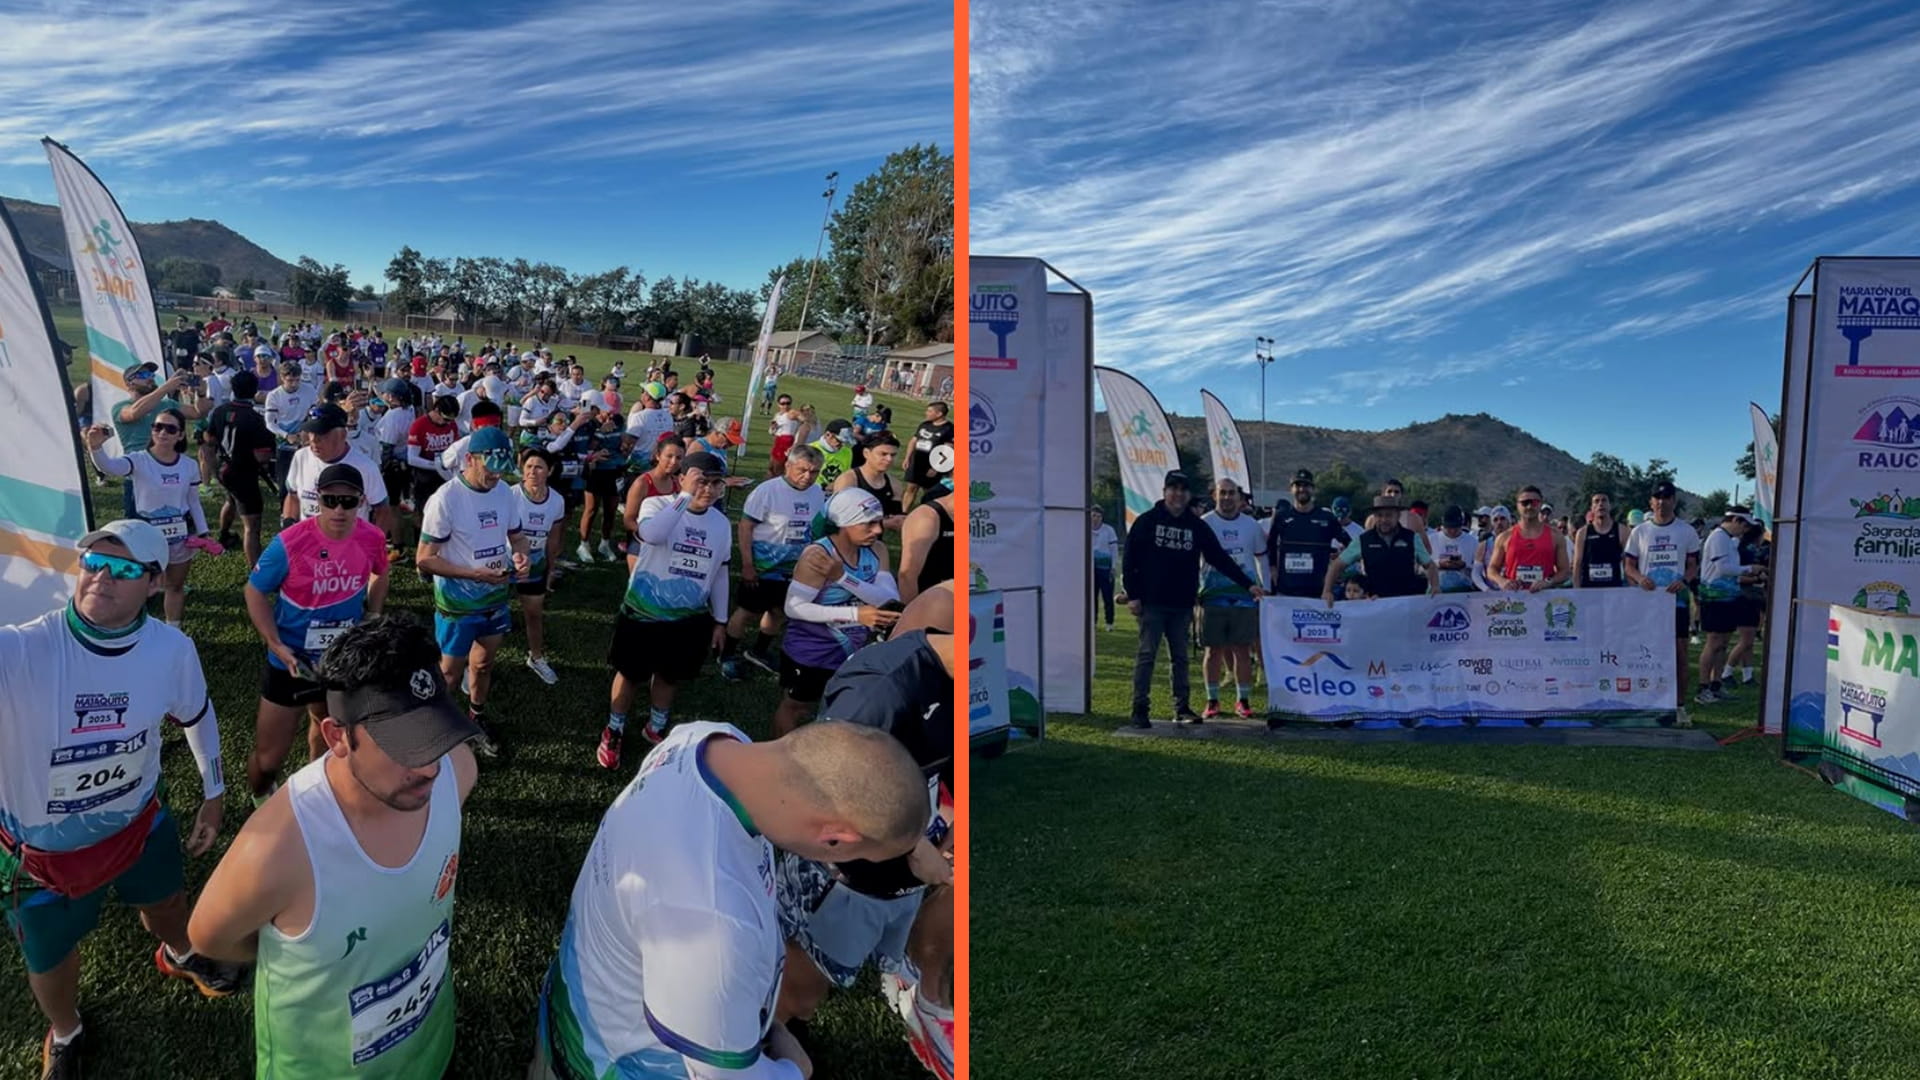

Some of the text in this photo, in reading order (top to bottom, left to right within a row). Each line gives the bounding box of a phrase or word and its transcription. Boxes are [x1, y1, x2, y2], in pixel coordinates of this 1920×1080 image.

[1839, 284, 1912, 296] MARATÓN DEL
[969, 294, 1018, 311] UITO
[969, 517, 996, 538] ilia
[312, 576, 362, 594] MOVE
[319, 634, 334, 645] 32
[1430, 632, 1470, 643] RAUCO
[1862, 628, 1918, 677] MA
[1285, 672, 1356, 696] celeo
[88, 714, 112, 724] 2025
[115, 736, 143, 753] 21K
[76, 763, 126, 792] 204
[387, 978, 431, 1026] 245
